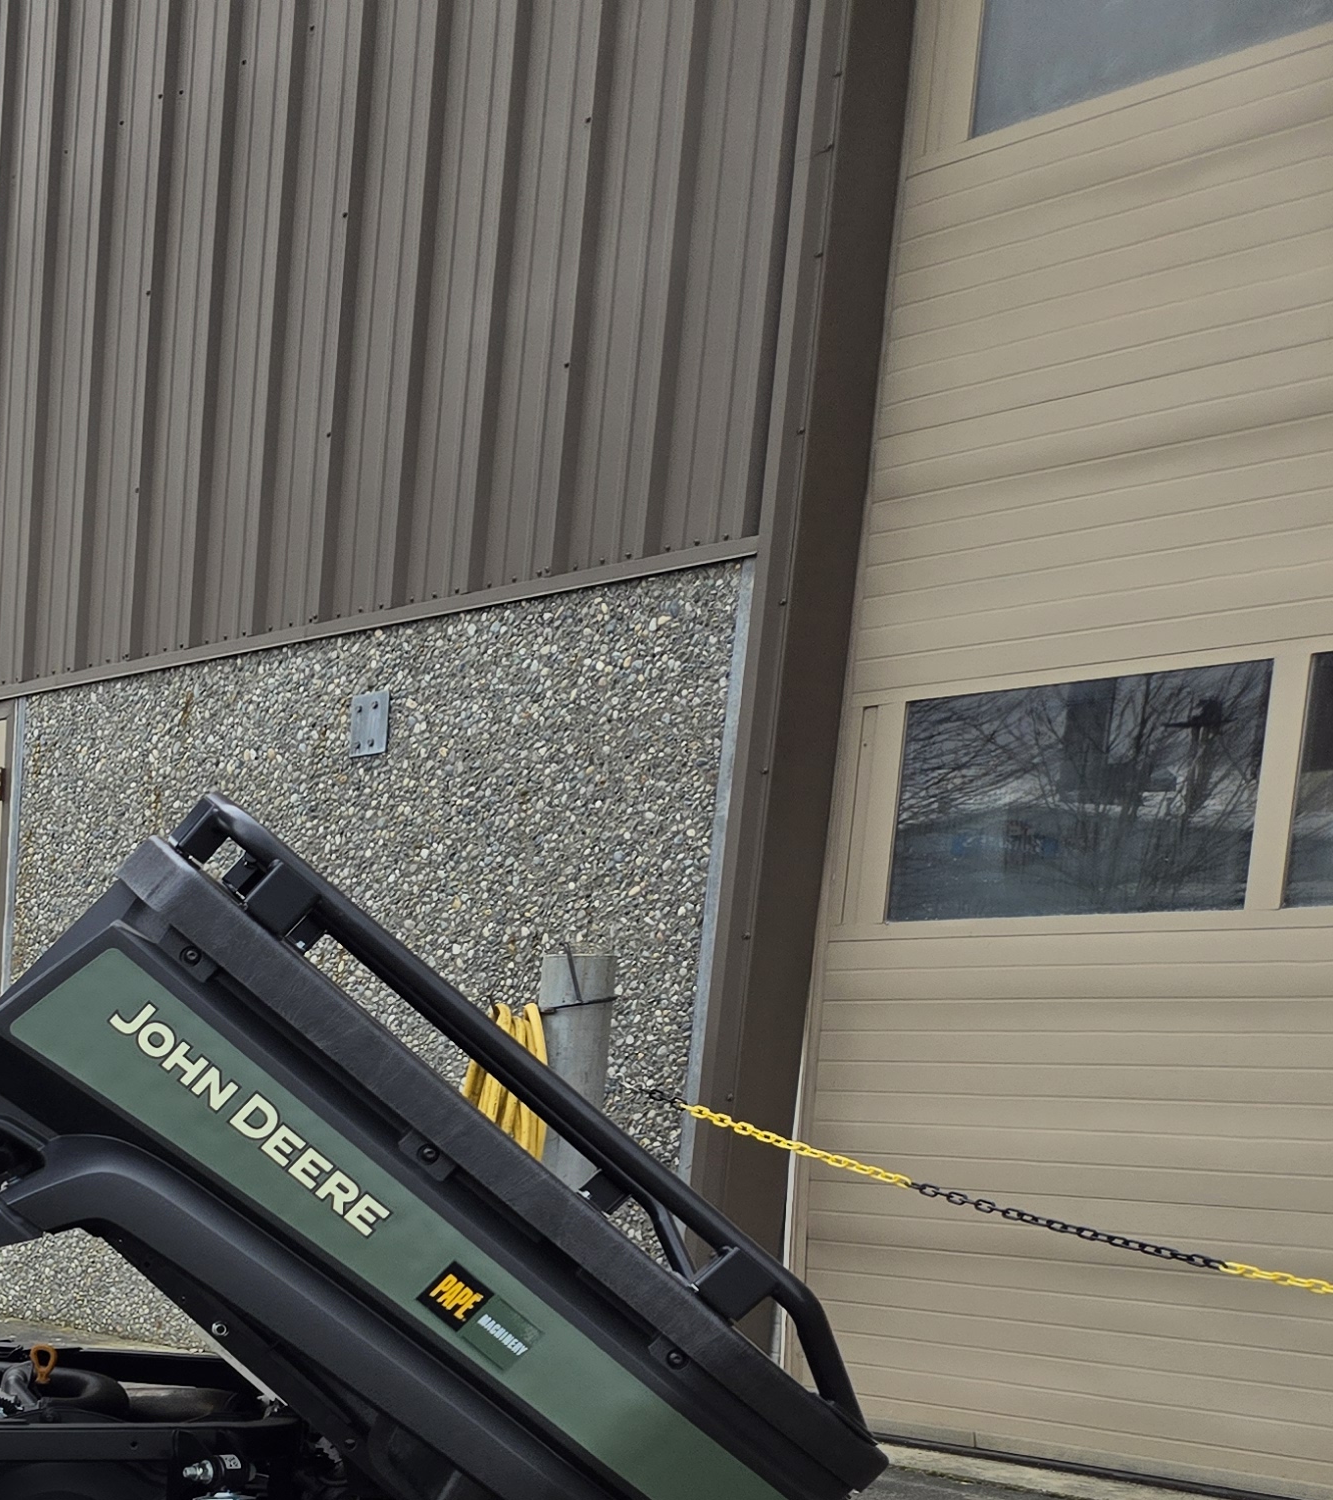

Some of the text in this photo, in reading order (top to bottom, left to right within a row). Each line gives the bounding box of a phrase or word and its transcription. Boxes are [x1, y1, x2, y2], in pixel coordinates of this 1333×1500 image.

[108, 1002, 392, 1238] JOHN DEERE
[477, 1314, 529, 1356] MACHINERY
